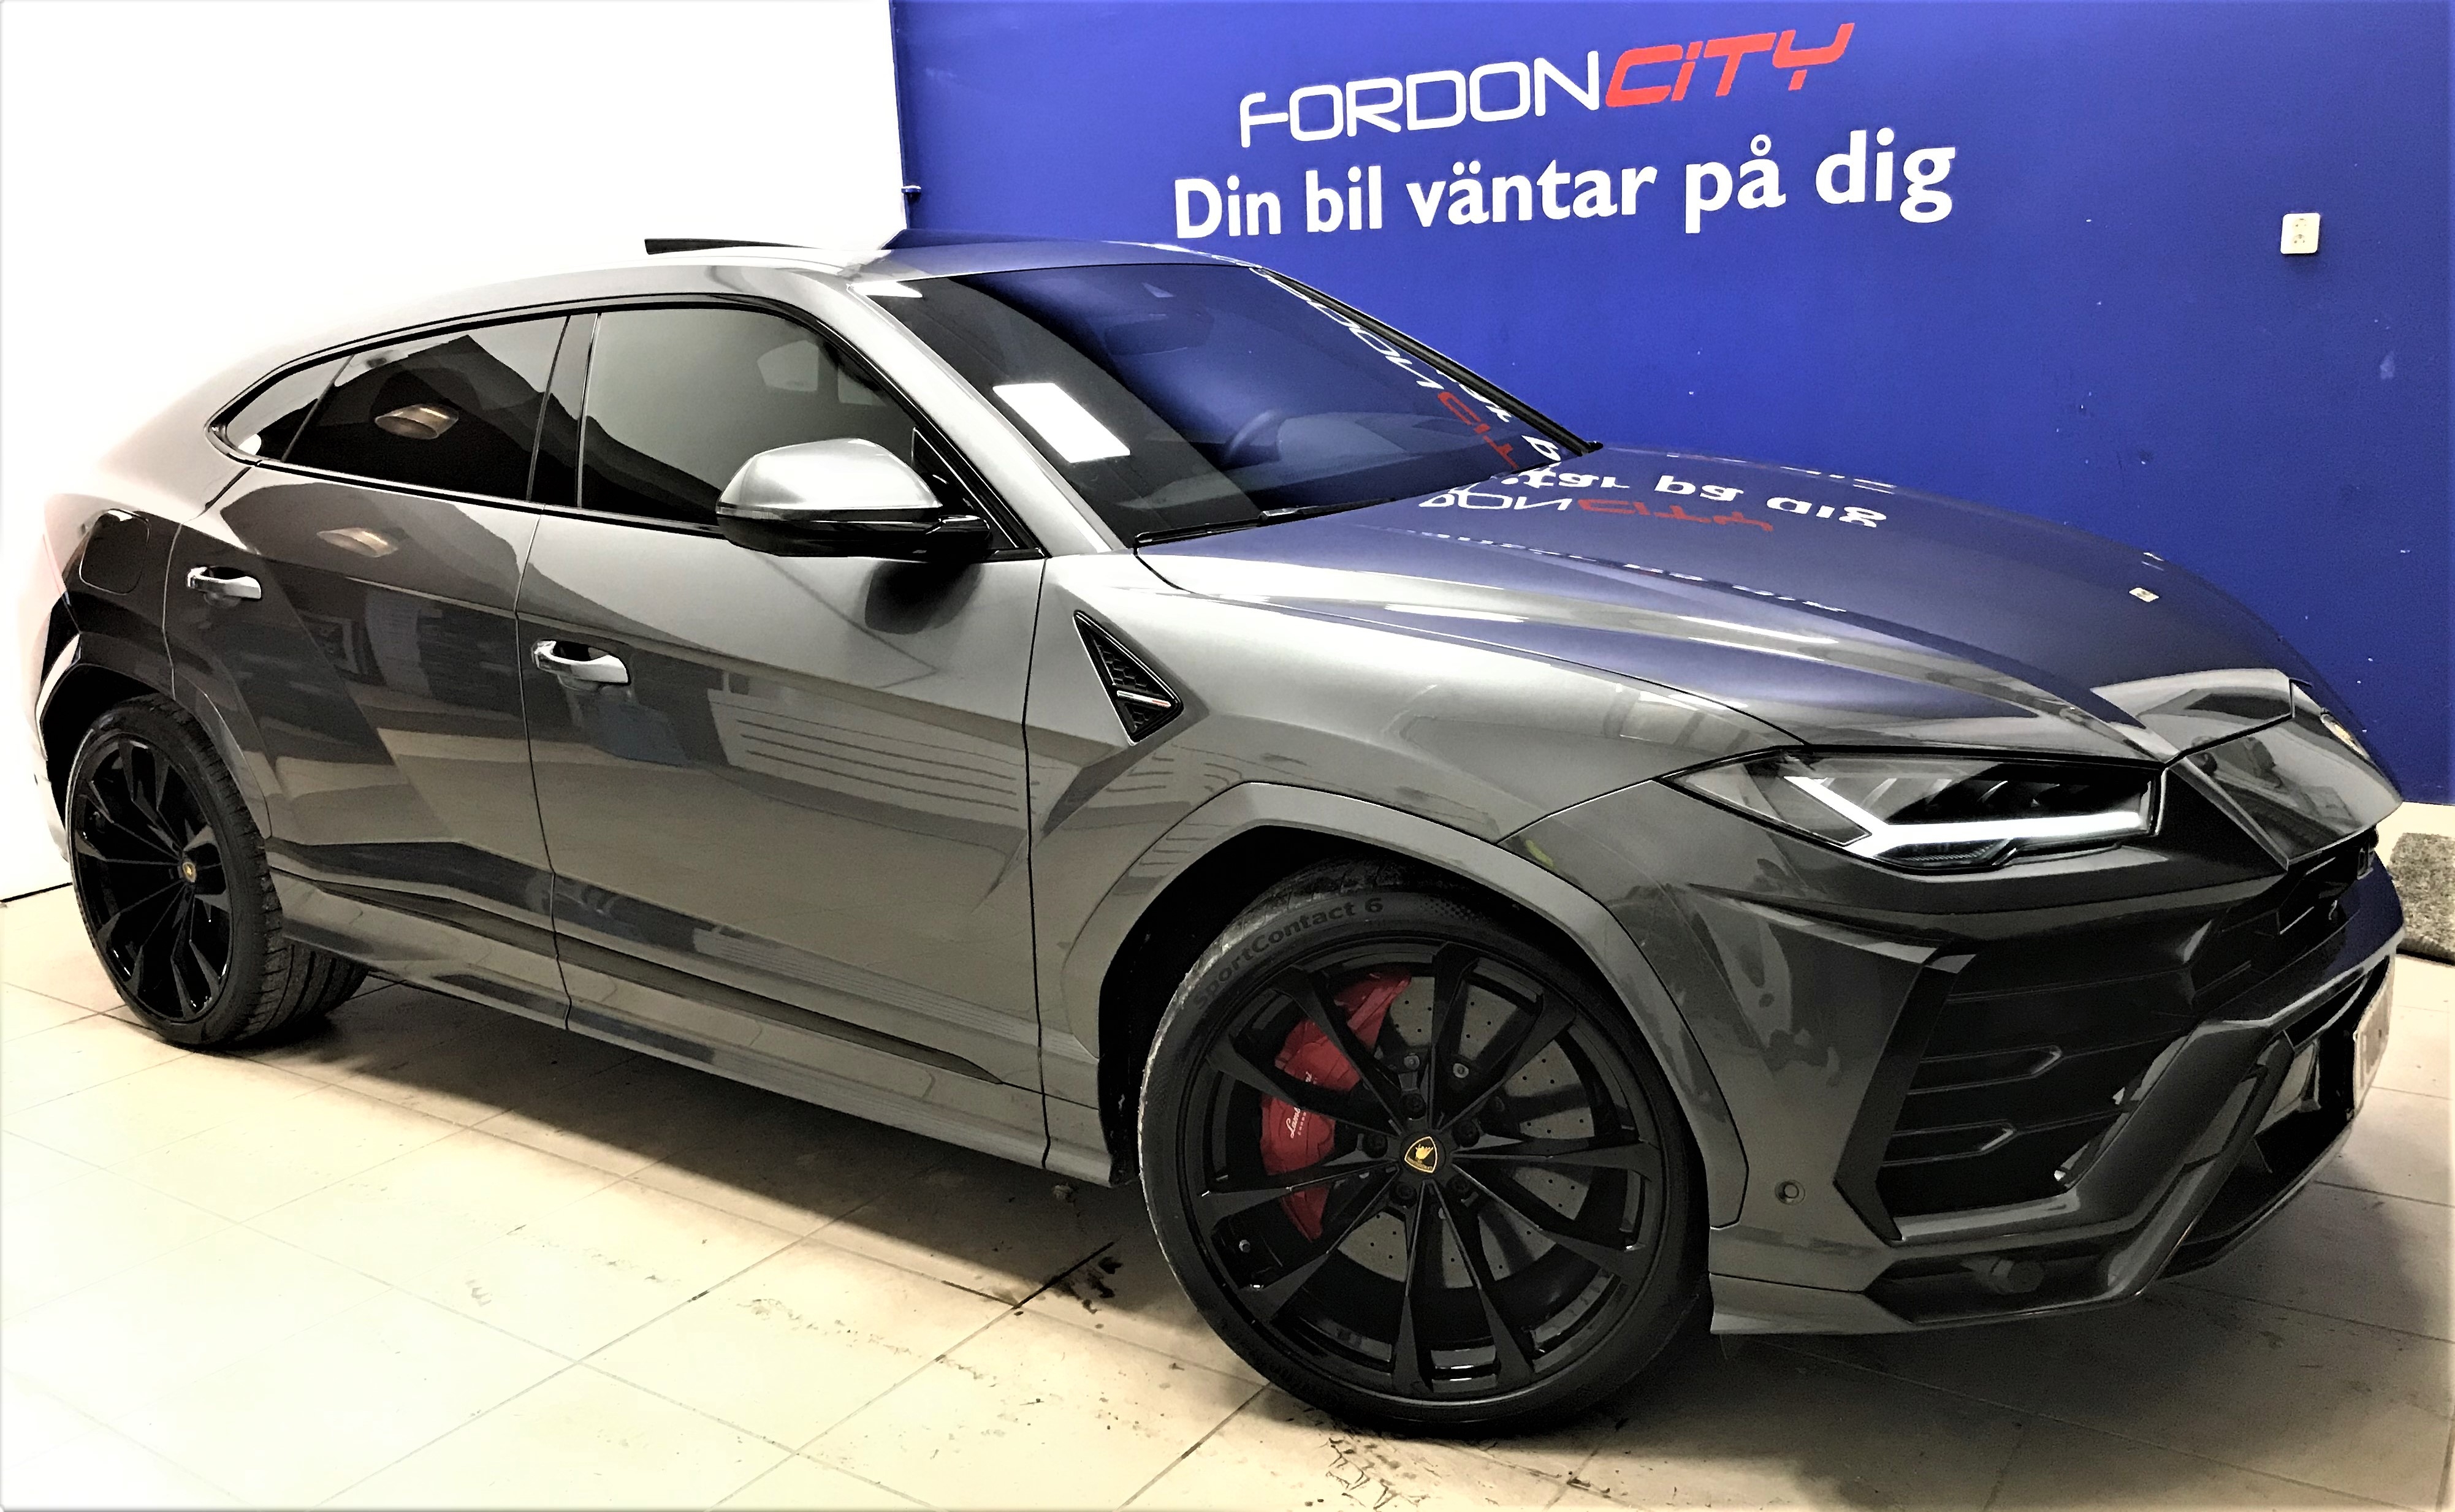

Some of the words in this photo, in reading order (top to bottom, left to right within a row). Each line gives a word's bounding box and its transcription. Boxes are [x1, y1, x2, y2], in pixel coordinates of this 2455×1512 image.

[1174, 175, 1282, 239] Din
[1305, 165, 1382, 233] bil
[1406, 159, 1658, 227] väntar
[1685, 134, 1786, 234] på
[1815, 127, 1956, 223] dig
[1193, 901, 1357, 1010] SportContact
[1364, 897, 1384, 914] 6
